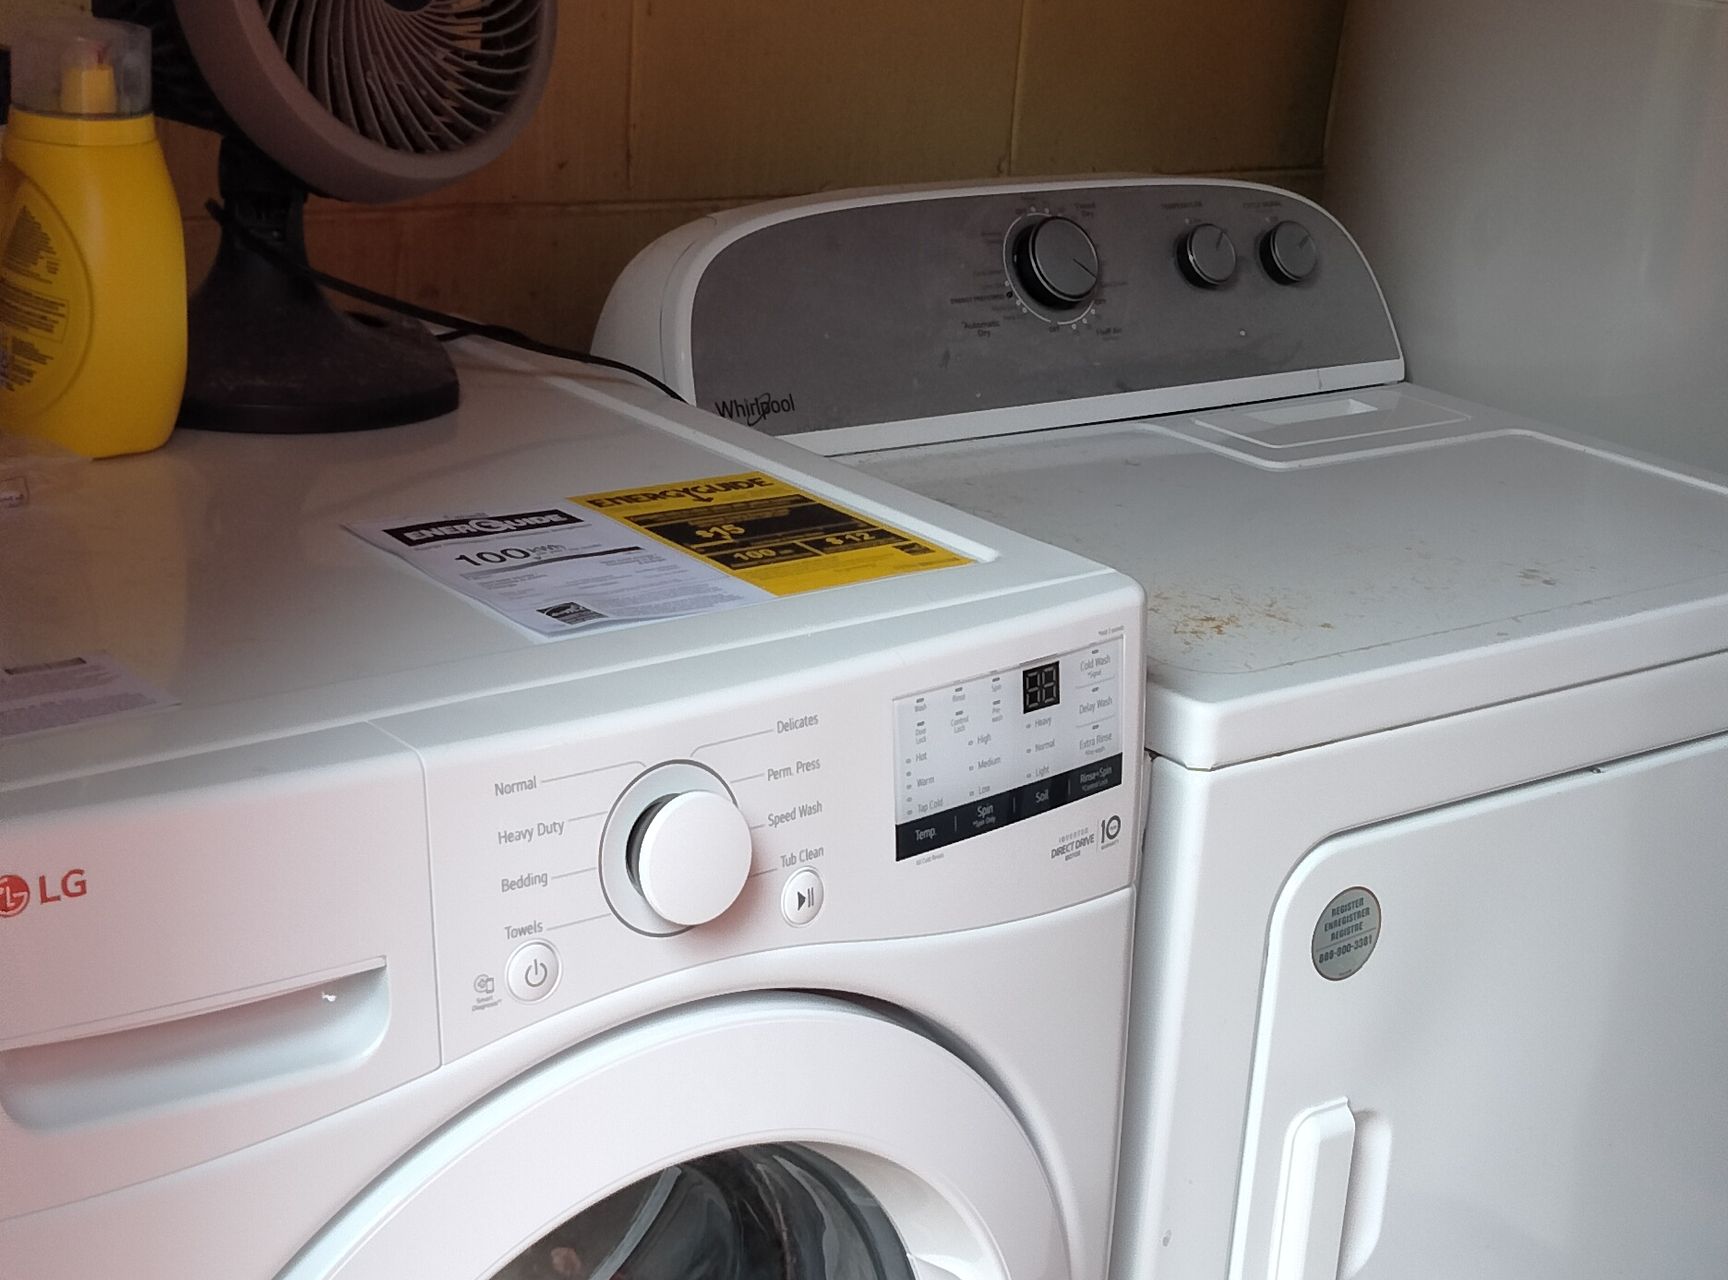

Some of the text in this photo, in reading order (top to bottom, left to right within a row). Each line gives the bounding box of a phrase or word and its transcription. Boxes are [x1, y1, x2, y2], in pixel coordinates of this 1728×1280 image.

[714, 393, 795, 424] Whirlpool
[455, 547, 531, 567] 100
[733, 548, 777, 562] 100
[1095, 654, 1111, 667] Wash
[1079, 695, 1113, 715] Delay Wash
[776, 714, 819, 734] Delicates
[977, 733, 992, 745] High
[1035, 738, 1056, 752] Normal
[1079, 731, 1113, 750] Extra Rinse
[915, 751, 928, 763] Hot
[978, 756, 1001, 770] Medium
[767, 758, 821, 782] Perm. Press
[1035, 765, 1050, 778] Light
[494, 776, 537, 797] Normal
[917, 776, 935, 787] Warm
[978, 785, 991, 795] Low
[918, 798, 944, 813] Tap Cold
[1035, 789, 1050, 803] Soil
[767, 800, 823, 829] Speed Wash
[977, 804, 994, 818] Spin
[497, 821, 565, 845] Heavy Duty
[915, 827, 937, 841] Temp.
[1100, 814, 1122, 844] 10
[1050, 833, 1095, 860] DIRECT DRIVE
[780, 846, 824, 869] Tub Clean
[39, 868, 88, 905] LG
[501, 872, 548, 893] Bedding
[504, 920, 543, 940] Towels
